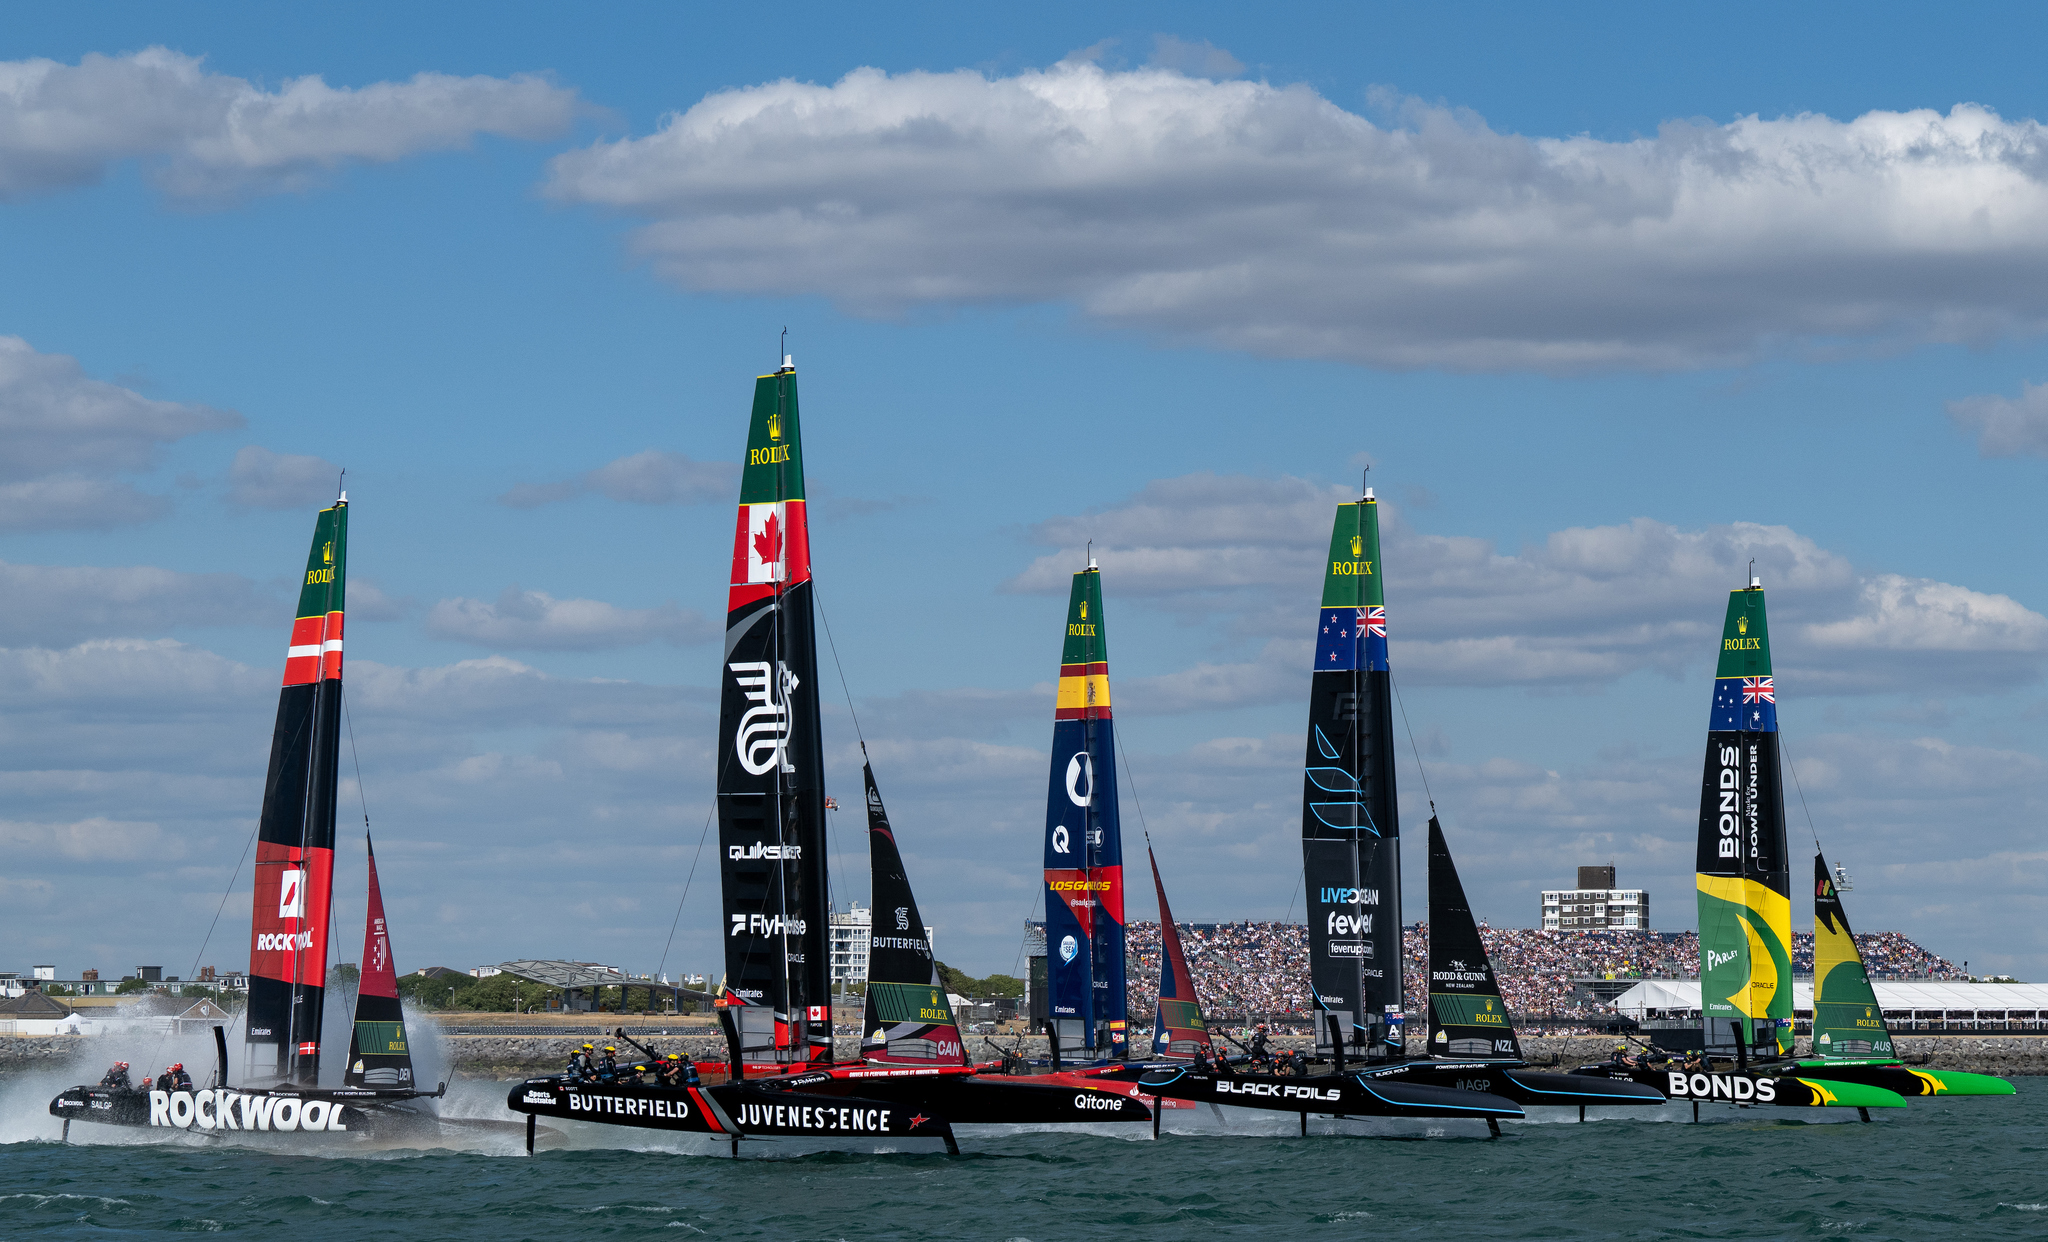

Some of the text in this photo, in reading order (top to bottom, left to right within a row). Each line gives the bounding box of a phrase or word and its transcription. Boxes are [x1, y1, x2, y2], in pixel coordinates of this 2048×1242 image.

[1332, 562, 1372, 575] ROLEX
[1069, 624, 1096, 636] ROLEX
[1724, 638, 1760, 650] ROLEX
[1718, 746, 1735, 858] BONDS
[1749, 744, 1758, 858] DOWN UNDER
[1328, 911, 1373, 935] fever
[872, 936, 928, 951] BUTTERFIELD
[1364, 969, 1383, 978] ORACLE
[1433, 971, 1486, 981] RODD & GUNN
[1751, 981, 1774, 989] ORACLE
[736, 988, 763, 998] Emirates
[1320, 995, 1343, 1004] Emirates
[1709, 1003, 1732, 1011] Emirates
[920, 1007, 947, 1021] ROLEX
[1475, 1013, 1502, 1023] ROLEX
[1856, 1018, 1880, 1028] ROLEX
[251, 1027, 272, 1036] Emirates
[388, 1041, 406, 1051] ROLEX
[937, 1040, 960, 1057] CAN
[1494, 1039, 1514, 1052] NZL
[1873, 1041, 1891, 1052] AUS
[399, 1068, 411, 1081] DEN
[1216, 1080, 1341, 1101] BLACK FOILS
[1466, 1079, 1490, 1091] AGP
[1669, 1072, 1775, 1102] BONDS
[523, 1095, 557, 1105] Illustrated
[528, 1090, 551, 1098] Sports
[149, 1089, 347, 1131] ROCKWOOL
[569, 1093, 689, 1119] BUTTERFIELD
[737, 1103, 891, 1132] JUVENESCENCE
